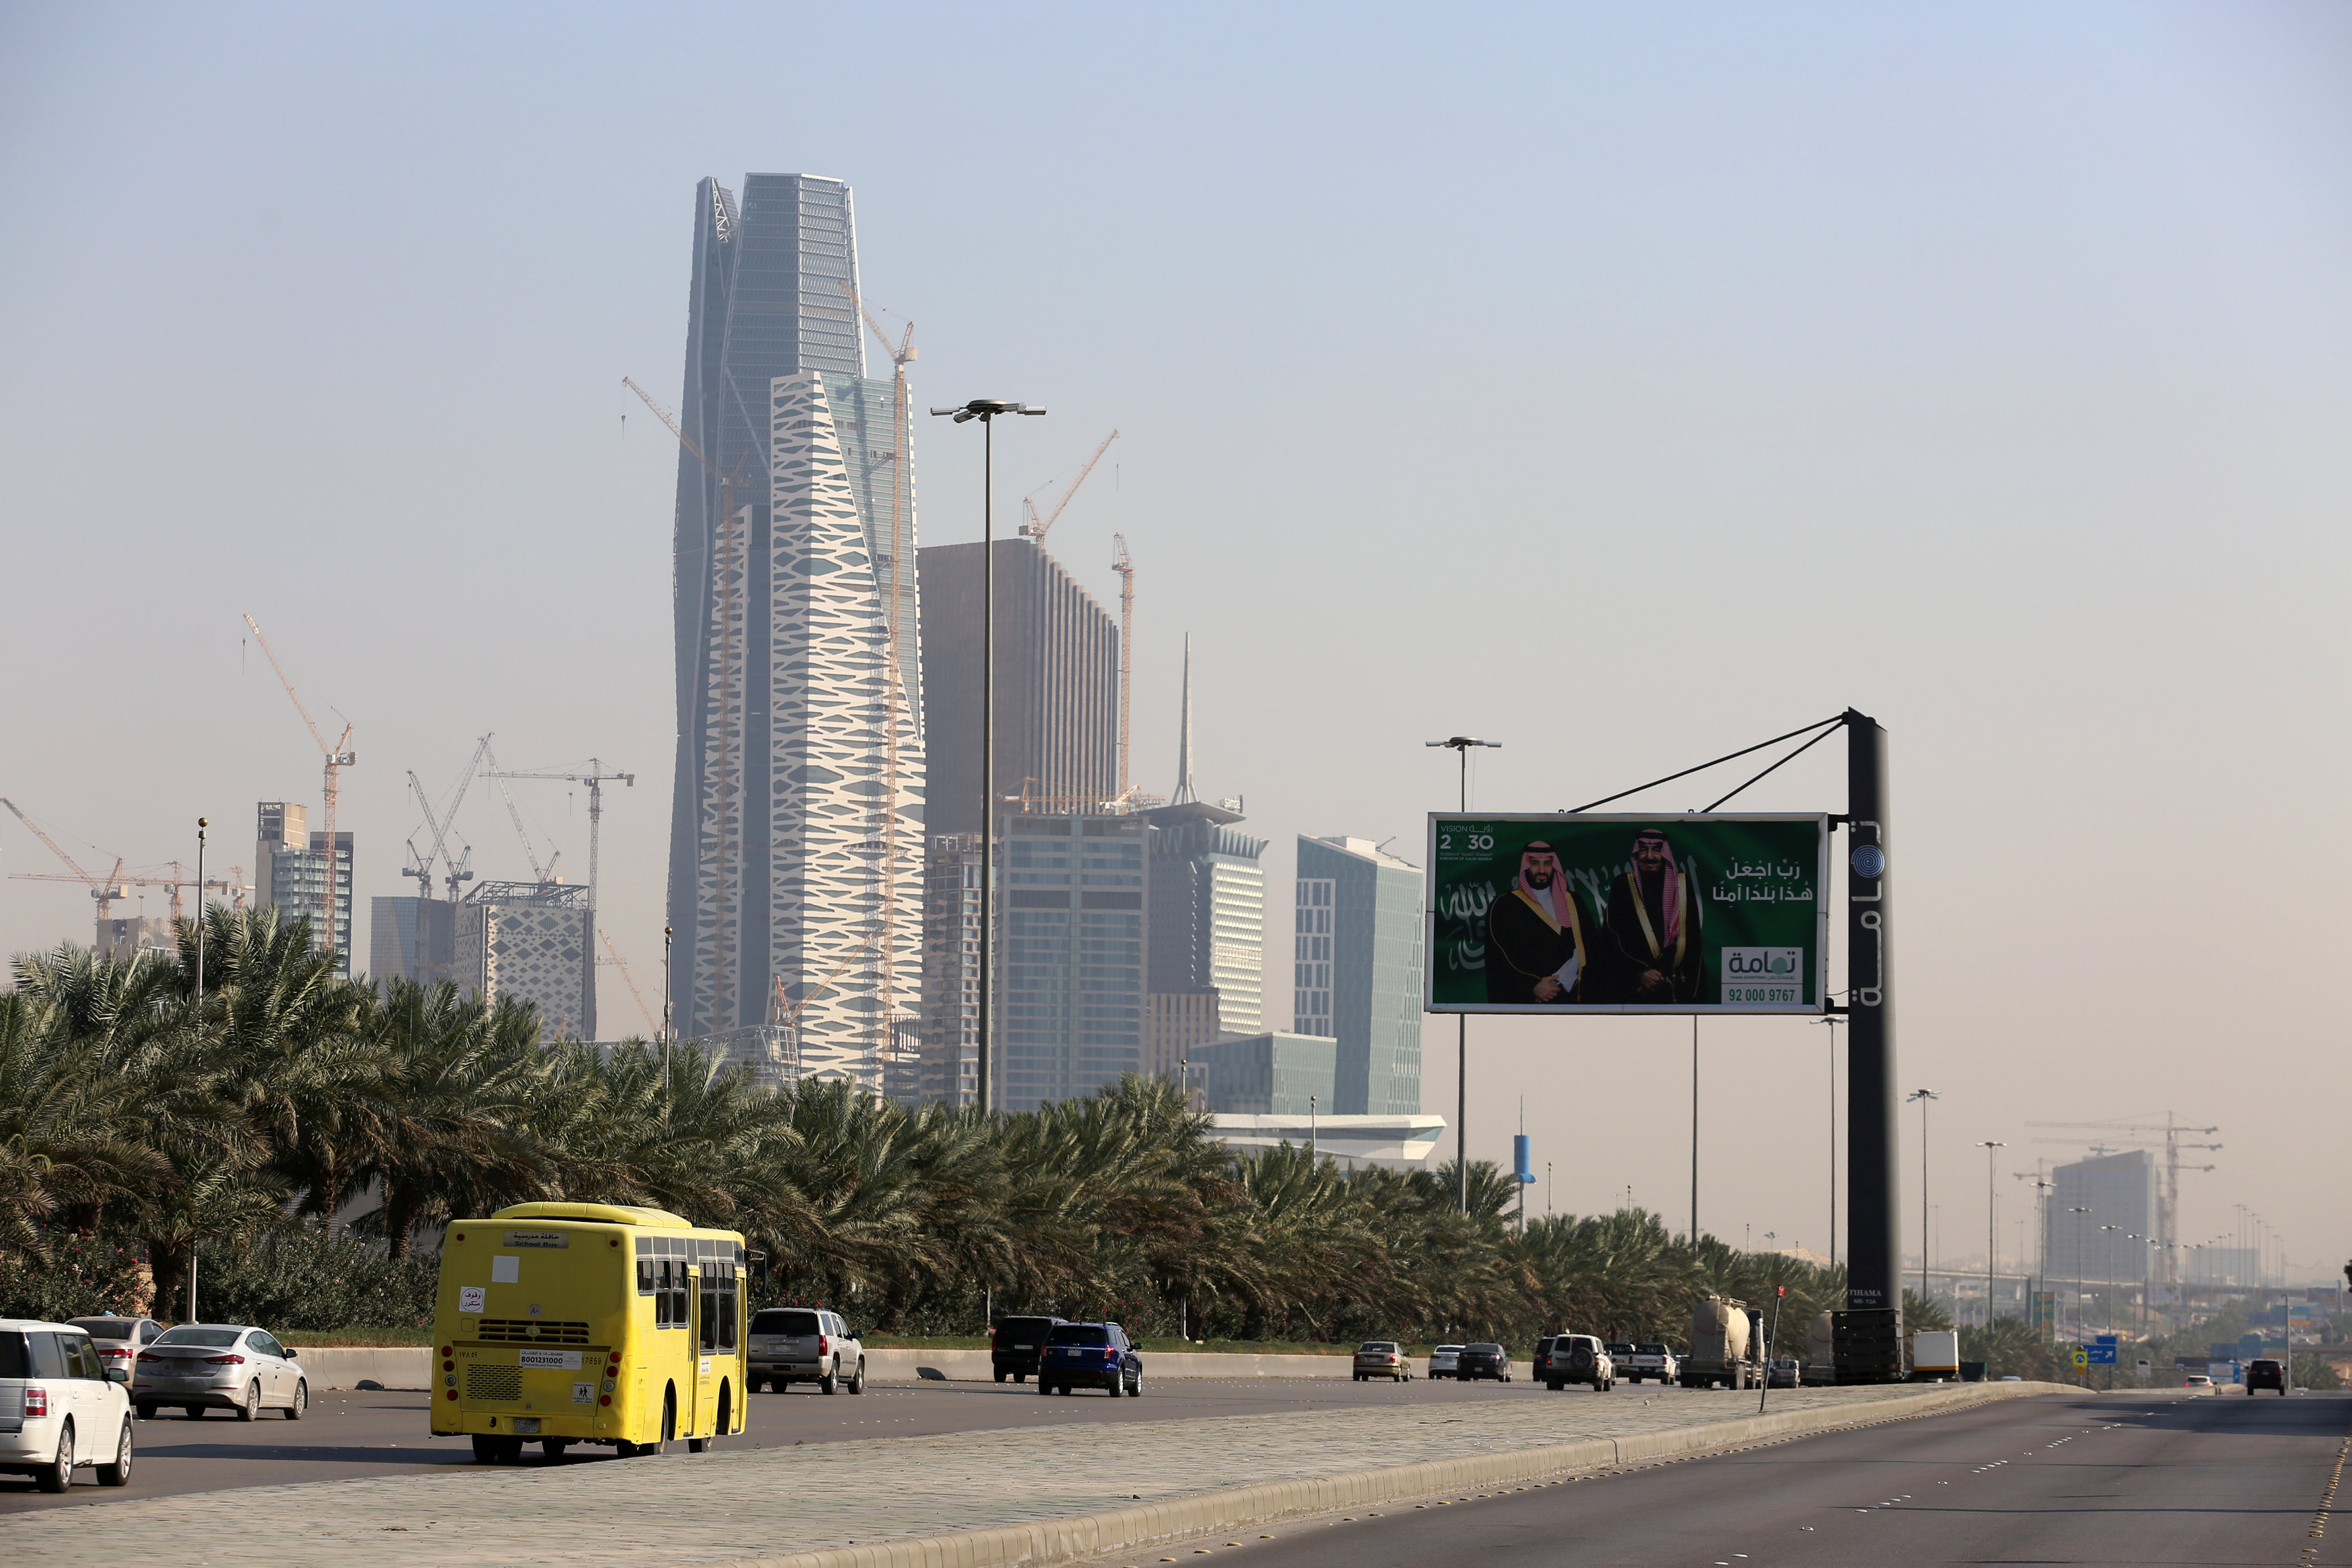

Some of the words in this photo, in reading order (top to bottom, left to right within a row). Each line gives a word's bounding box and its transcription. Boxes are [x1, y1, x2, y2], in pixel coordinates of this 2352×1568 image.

[1440, 834, 1494, 850] 230
[1729, 989, 1742, 1001] 92
[1746, 989, 1765, 1001] 000
[1769, 989, 1795, 1002] 9767
[521, 1356, 563, 1364] 8001231000
